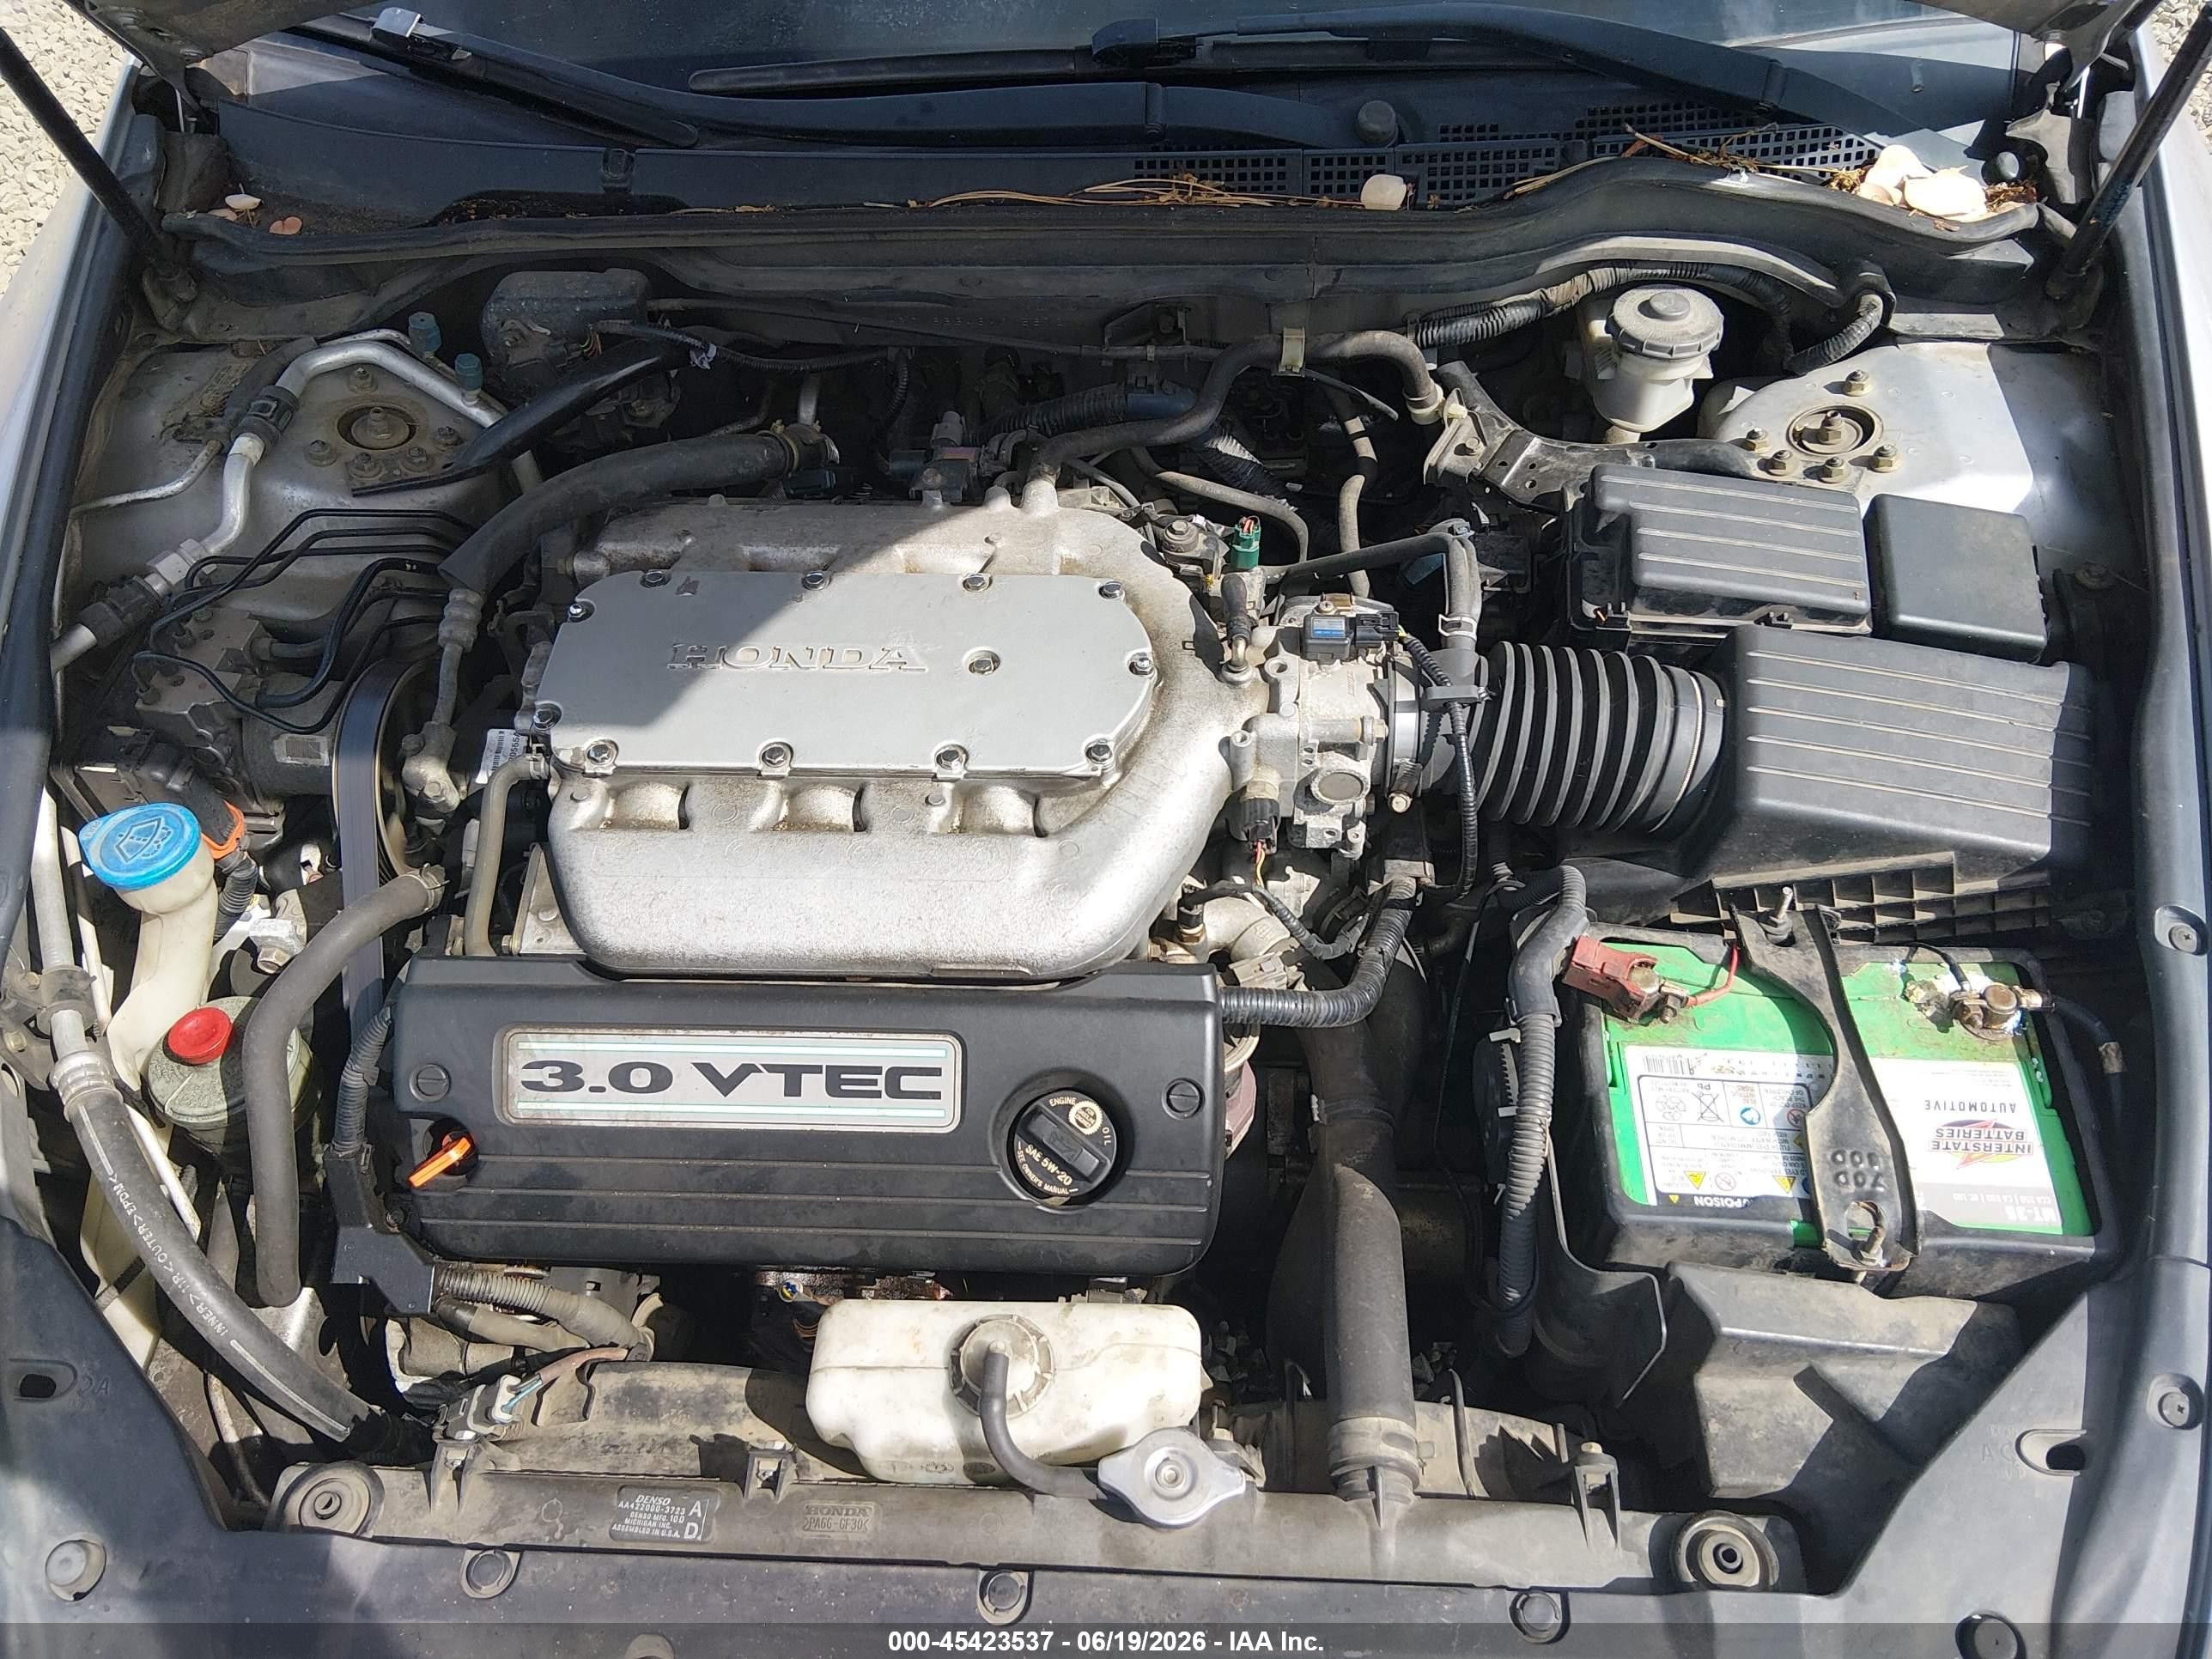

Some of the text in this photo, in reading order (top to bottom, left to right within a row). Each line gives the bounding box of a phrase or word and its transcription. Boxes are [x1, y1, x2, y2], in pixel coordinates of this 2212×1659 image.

[667, 643, 928, 672] HONDA
[520, 1060, 942, 1101] 3.0 VTEC
[1924, 1100, 2016, 1114] AUTOMOTIVE
[1049, 1097, 1111, 1146] ENGINE OIL
[1936, 1128, 2025, 1140] BATTERIES
[1932, 1140, 2032, 1154] INTERSTATE
[1025, 1144, 1073, 1186] SAE 5W-20
[635, 1495, 671, 1506] DENSO
[629, 1511, 652, 1520] DENSO
[688, 1500, 702, 1517] A
[804, 1506, 871, 1517] HONDA
[624, 1517, 657, 1528] MICHIGAN
[611, 1523, 651, 1534] ASSEMBLED
[684, 1522, 699, 1539] D
